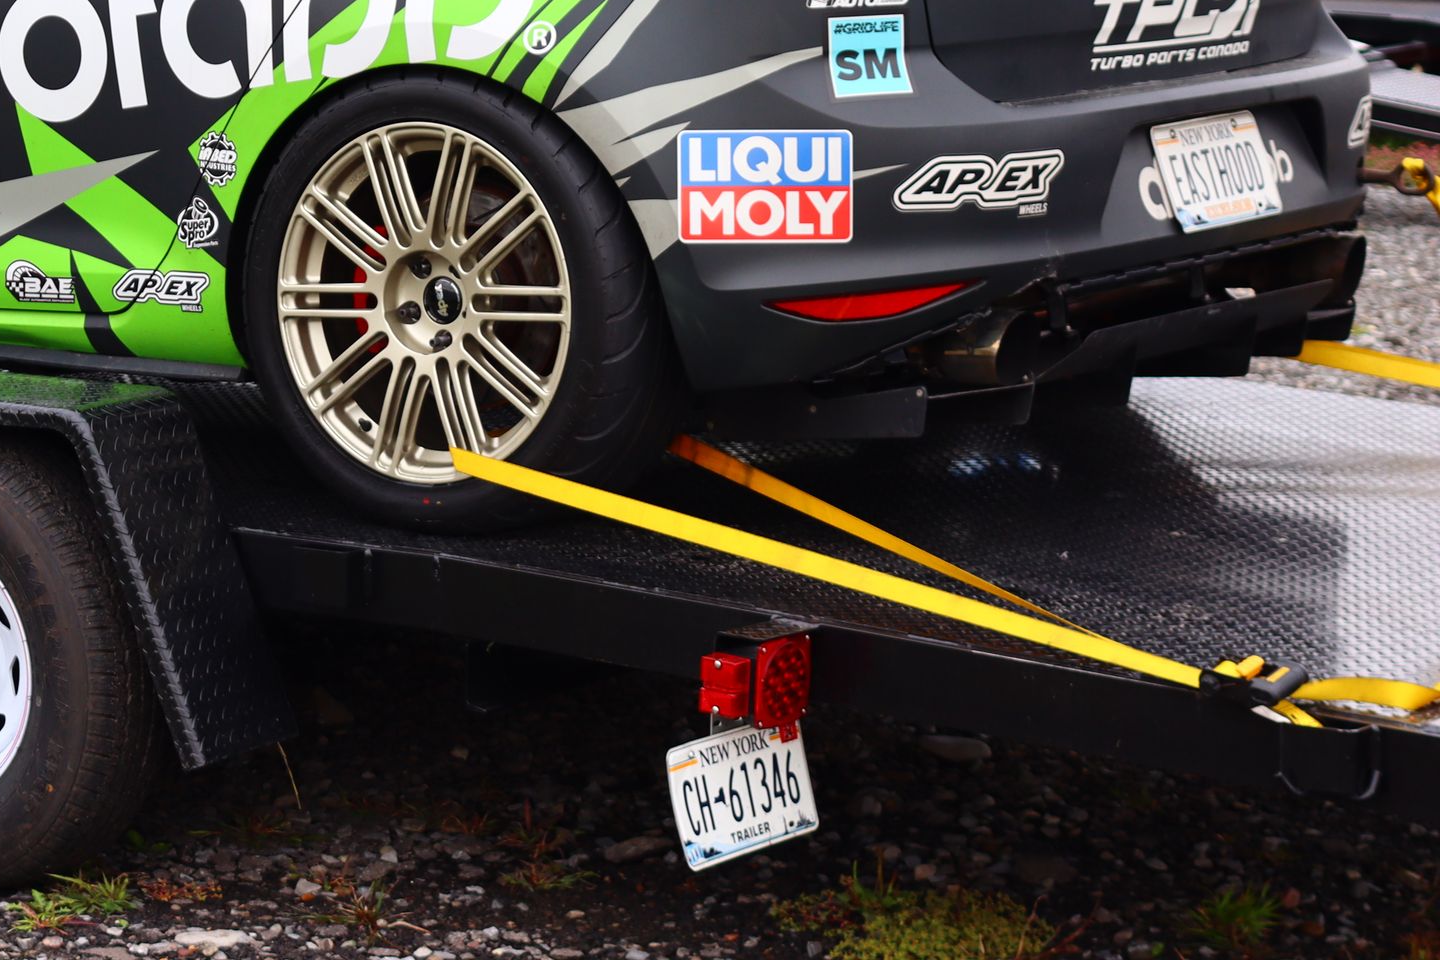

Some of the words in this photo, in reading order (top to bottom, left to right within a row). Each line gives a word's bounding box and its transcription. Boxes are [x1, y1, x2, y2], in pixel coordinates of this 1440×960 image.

[834, 21, 900, 34] #GRIDLIFE
[835, 48, 901, 81] SM
[1179, 127, 1204, 148] NEW
[1204, 123, 1234, 144] YORK
[689, 136, 842, 186] LIQUI
[1168, 141, 1265, 206] EASTHOOD
[903, 155, 1059, 204] APEX
[689, 189, 848, 236] MOLY
[1018, 202, 1049, 216] WHEELS
[24, 278, 73, 294] BAE
[116, 272, 206, 300] APEX
[181, 304, 202, 313] WHEELS
[698, 742, 733, 768] NEW
[733, 729, 770, 758] YORK
[730, 821, 772, 844] TRAILER
